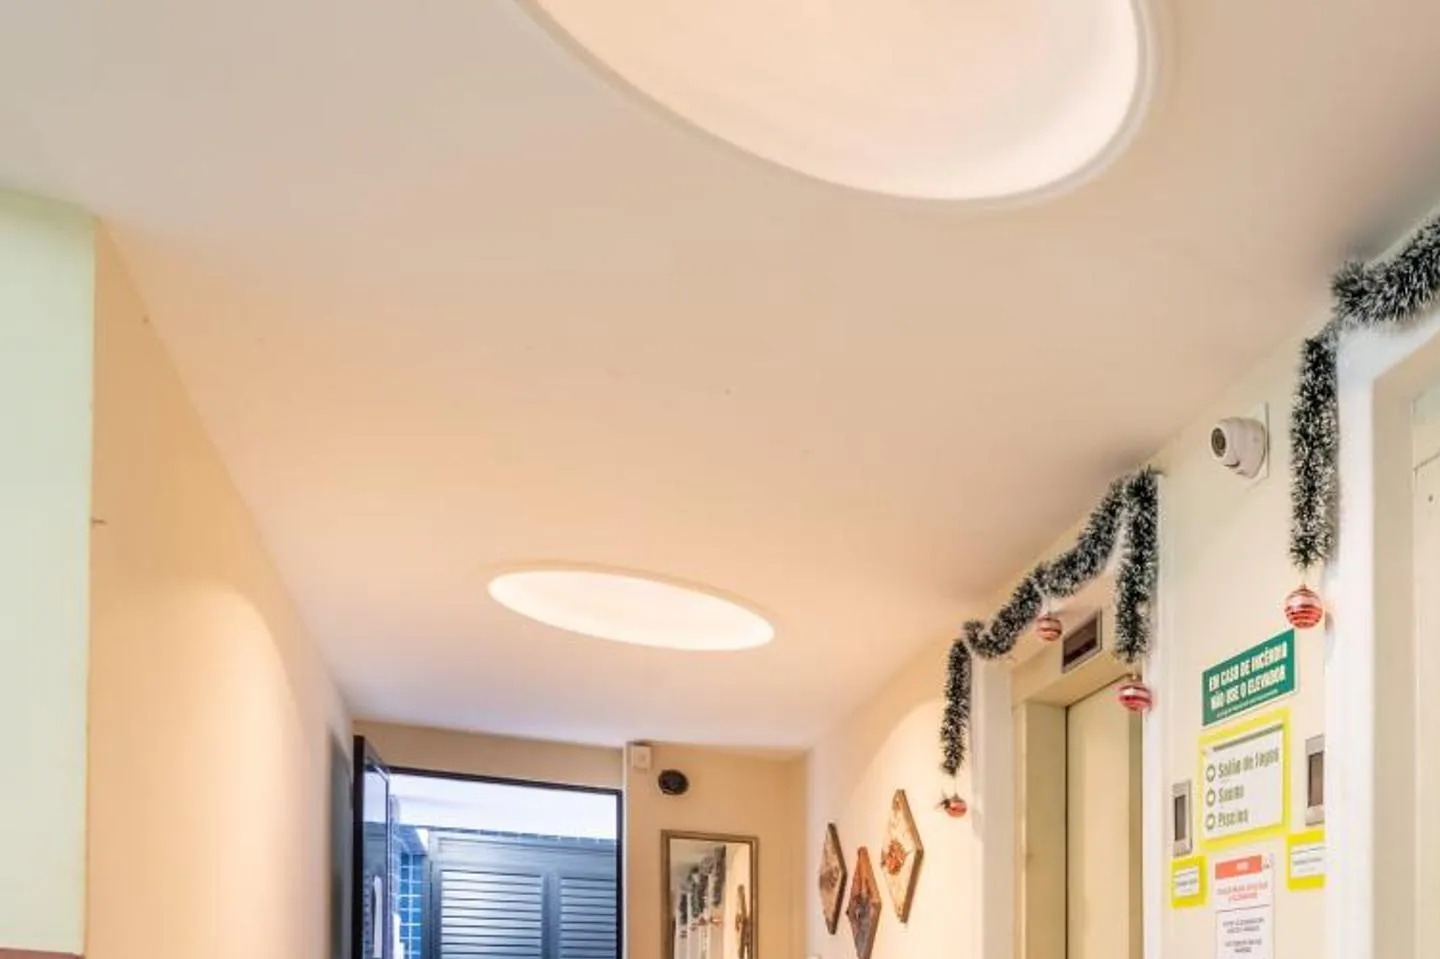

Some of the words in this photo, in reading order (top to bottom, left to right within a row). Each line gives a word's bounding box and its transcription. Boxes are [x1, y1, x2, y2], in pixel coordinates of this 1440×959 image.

[1209, 673, 1220, 692] EM
[1221, 664, 1239, 686] CASO
[1240, 659, 1251, 677] DE
[1211, 690, 1224, 710] NÃO
[1226, 684, 1240, 704] USE
[1240, 681, 1247, 698] O
[1247, 664, 1286, 695] ELEVADOR
